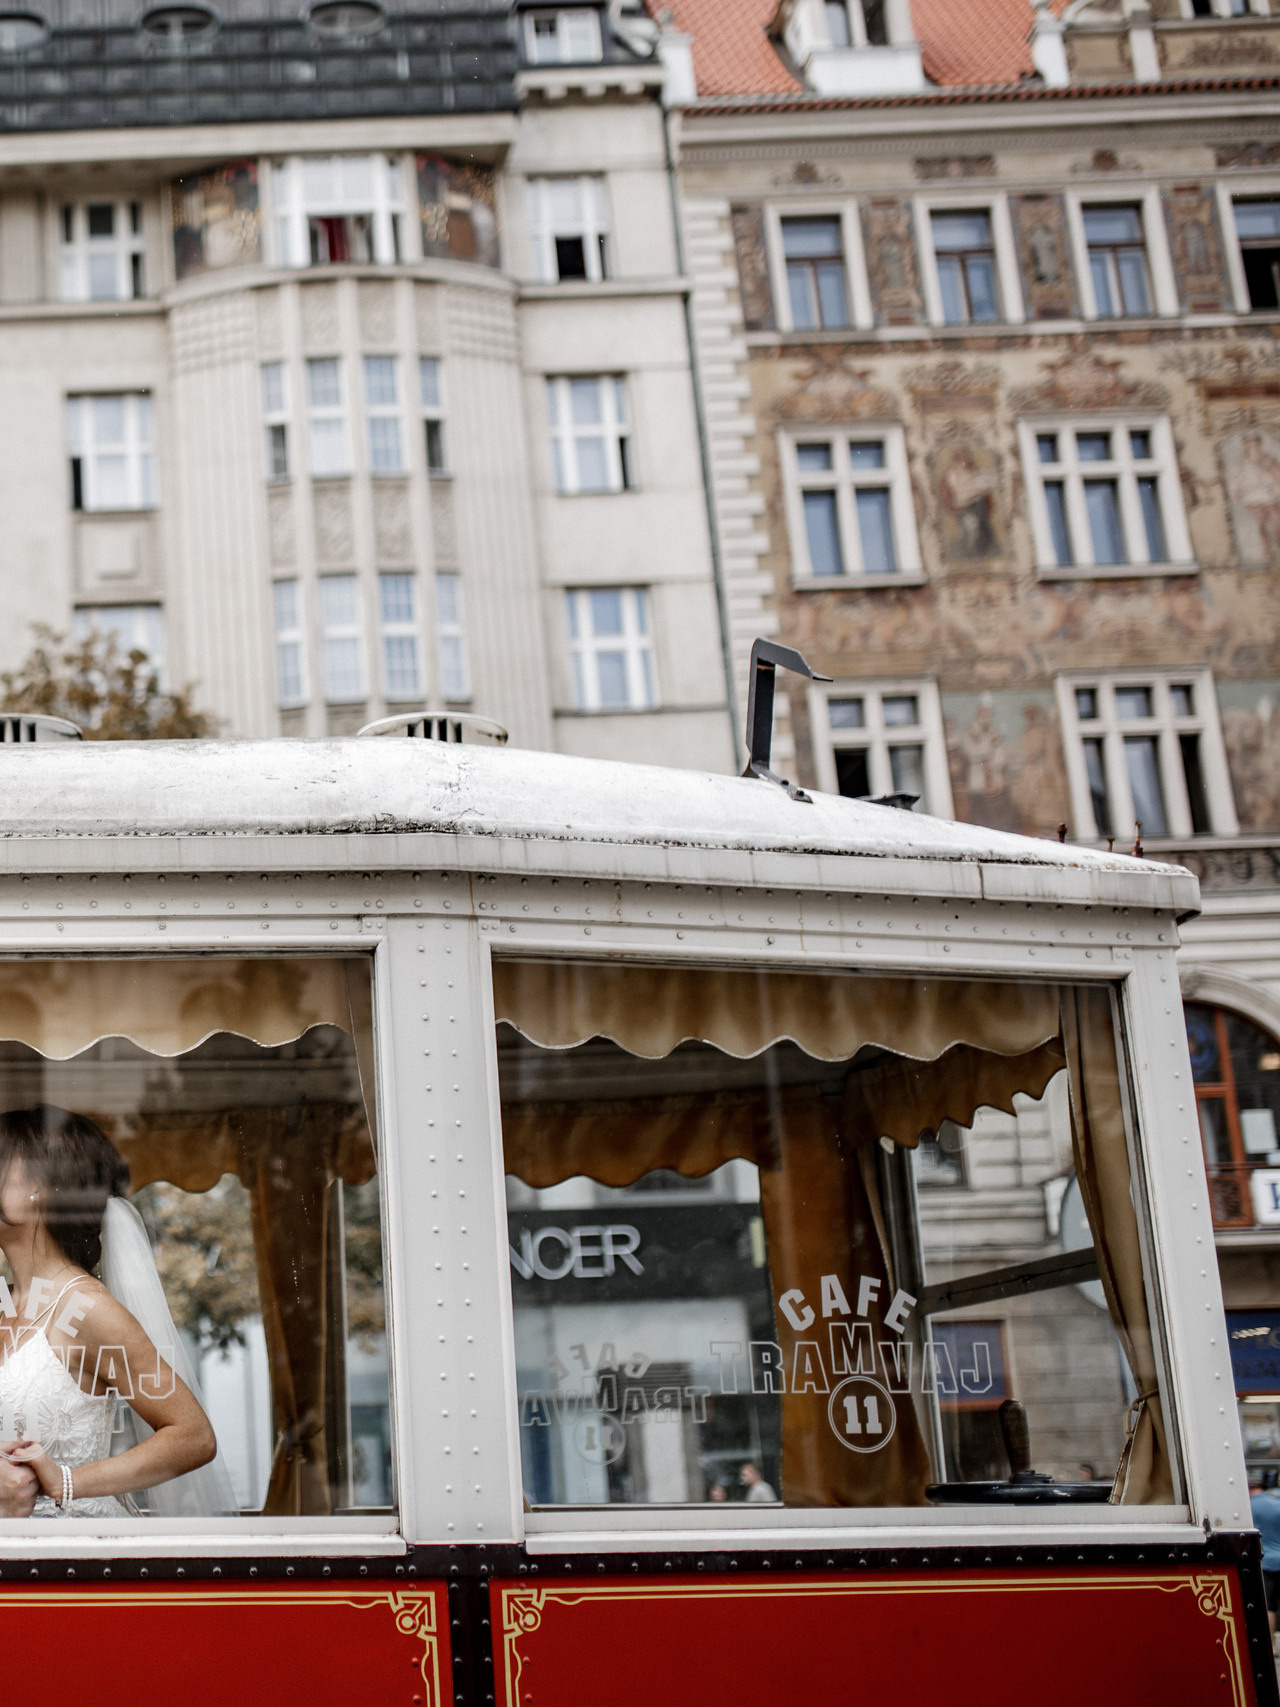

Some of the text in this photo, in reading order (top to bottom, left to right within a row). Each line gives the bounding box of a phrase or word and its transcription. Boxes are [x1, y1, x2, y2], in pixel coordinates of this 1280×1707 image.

[779, 1274, 917, 1334] CAFE
[710, 1322, 993, 1394] TRAMVAJ
[843, 1395, 883, 1434] 11
